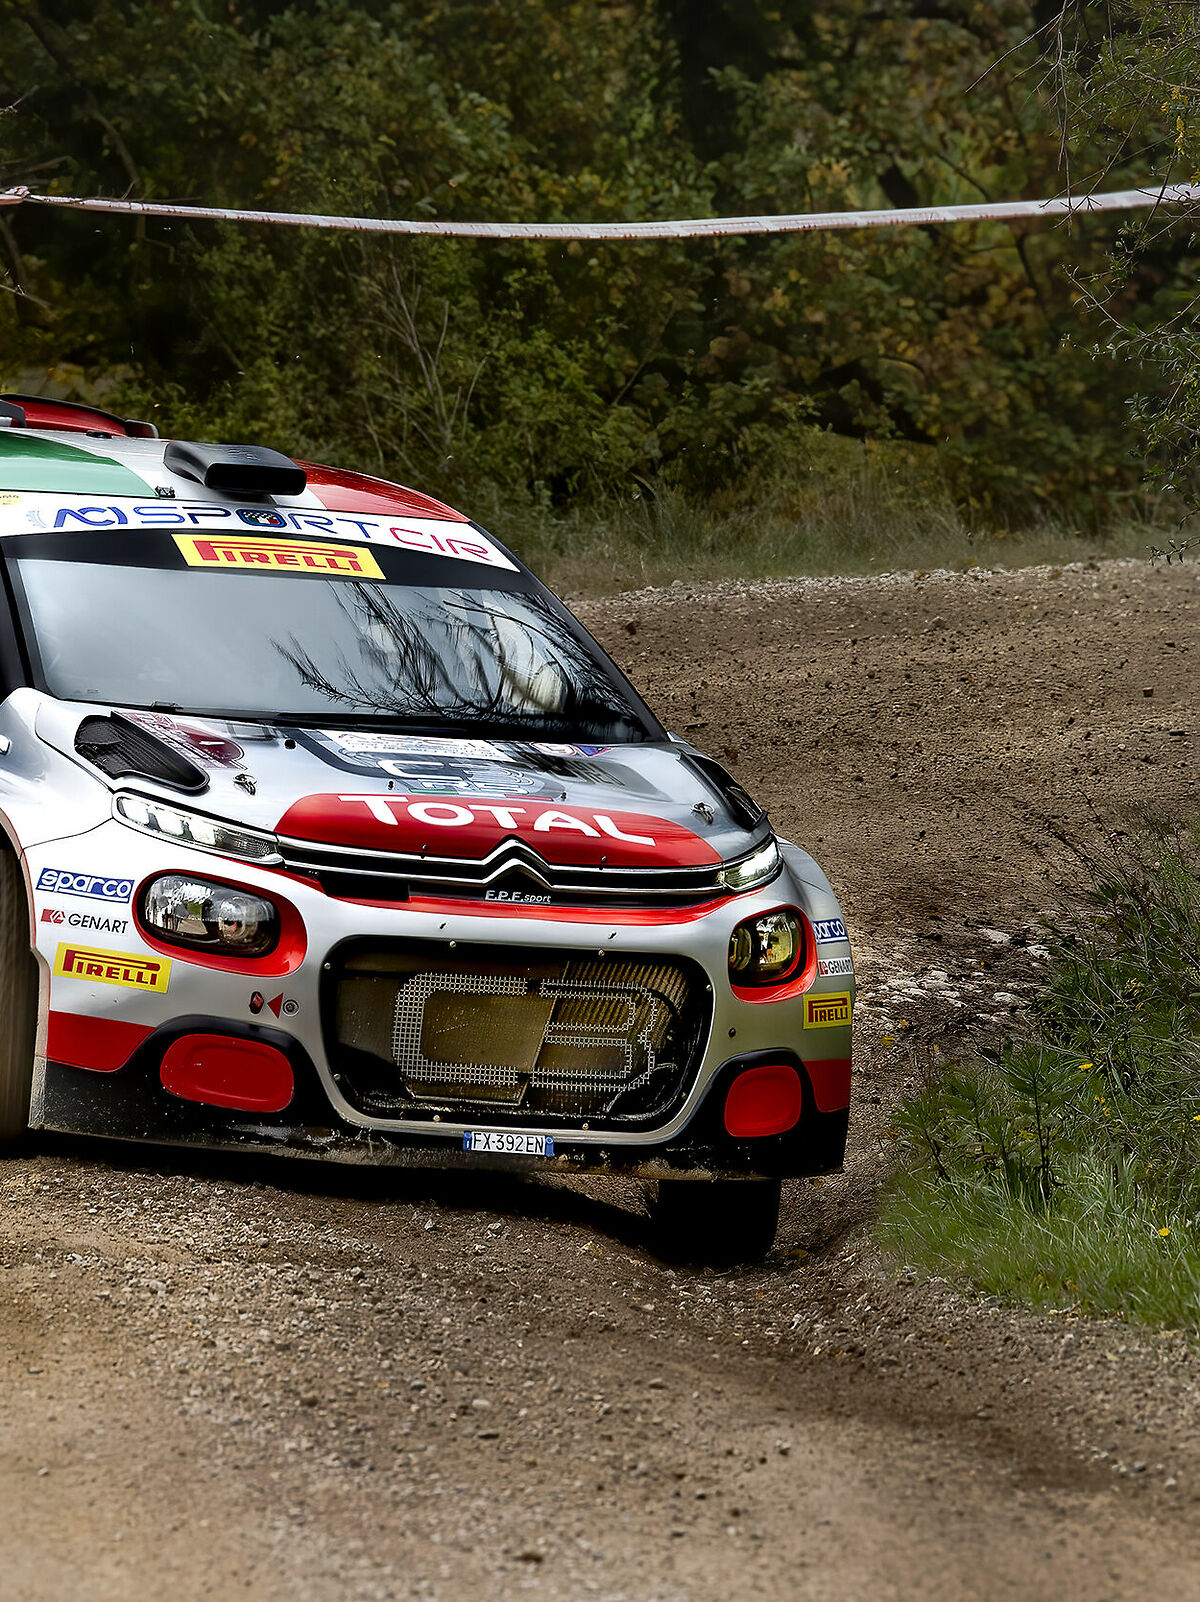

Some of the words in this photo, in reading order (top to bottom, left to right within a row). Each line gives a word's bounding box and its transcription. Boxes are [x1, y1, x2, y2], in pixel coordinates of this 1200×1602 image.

[133, 506, 379, 538] SPORT
[389, 526, 493, 561] CIR
[192, 539, 363, 572] PIRELLI
[338, 794, 656, 847] TOTAL
[41, 870, 133, 899] sparco
[68, 913, 129, 934] GENART
[62, 949, 161, 986] PIRELLI
[807, 997, 848, 1023] PIRELLI
